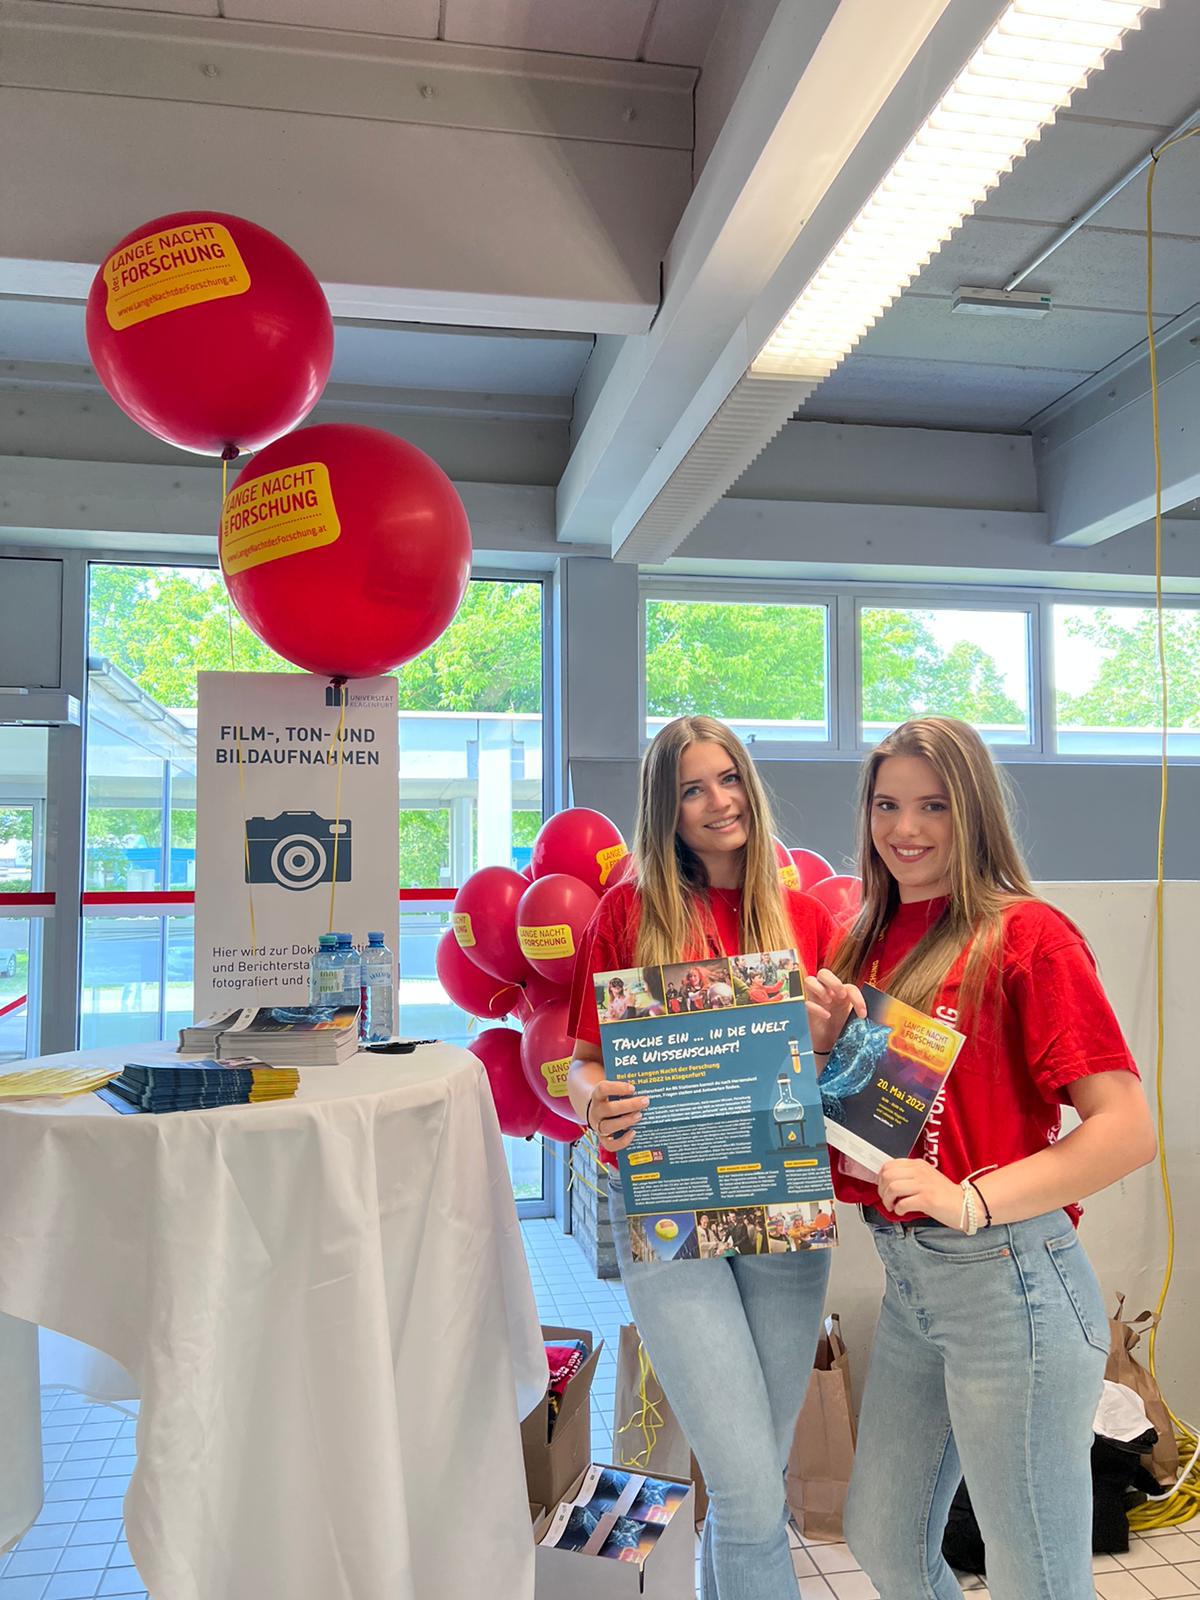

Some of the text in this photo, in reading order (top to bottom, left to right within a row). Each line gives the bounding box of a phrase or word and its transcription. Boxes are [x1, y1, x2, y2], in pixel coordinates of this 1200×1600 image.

[111, 226, 217, 273] LANGE NACHT
[121, 243, 225, 288] FORSCHUNG
[226, 468, 316, 514] LANGE NACHT
[229, 489, 319, 534] FORSCHUNG
[220, 725, 376, 744] FILM-, TON- UND
[215, 749, 380, 765] BILDAUFNAHMEN
[524, 936, 568, 948] FORSCHUNG
[539, 928, 565, 938] NACHT
[212, 947, 237, 957] Hier
[241, 946, 266, 957] wird
[269, 947, 289, 956] zur
[212, 960, 310, 973] und Berichtersta
[212, 976, 279, 991] fotografiert
[282, 975, 304, 986] und
[612, 1035, 663, 1051] TAUCHE
[668, 1032, 689, 1045] EIN
[709, 1029, 723, 1040] IN
[727, 1026, 746, 1037] DIE
[750, 1020, 790, 1035] WELT
[903, 1020, 949, 1044] LANGE NACHT
[905, 1030, 946, 1053] FORSCHUNG
[614, 1040, 740, 1068] DER WISSENSCHAFT!
[547, 1060, 572, 1075] LANG
[637, 1069, 660, 1078] Langen
[660, 1067, 678, 1075] Nacht
[688, 1063, 720, 1071] Forschung
[876, 1078, 889, 1092] 20.
[889, 1085, 905, 1100] Mai
[905, 1094, 927, 1113] 2022
